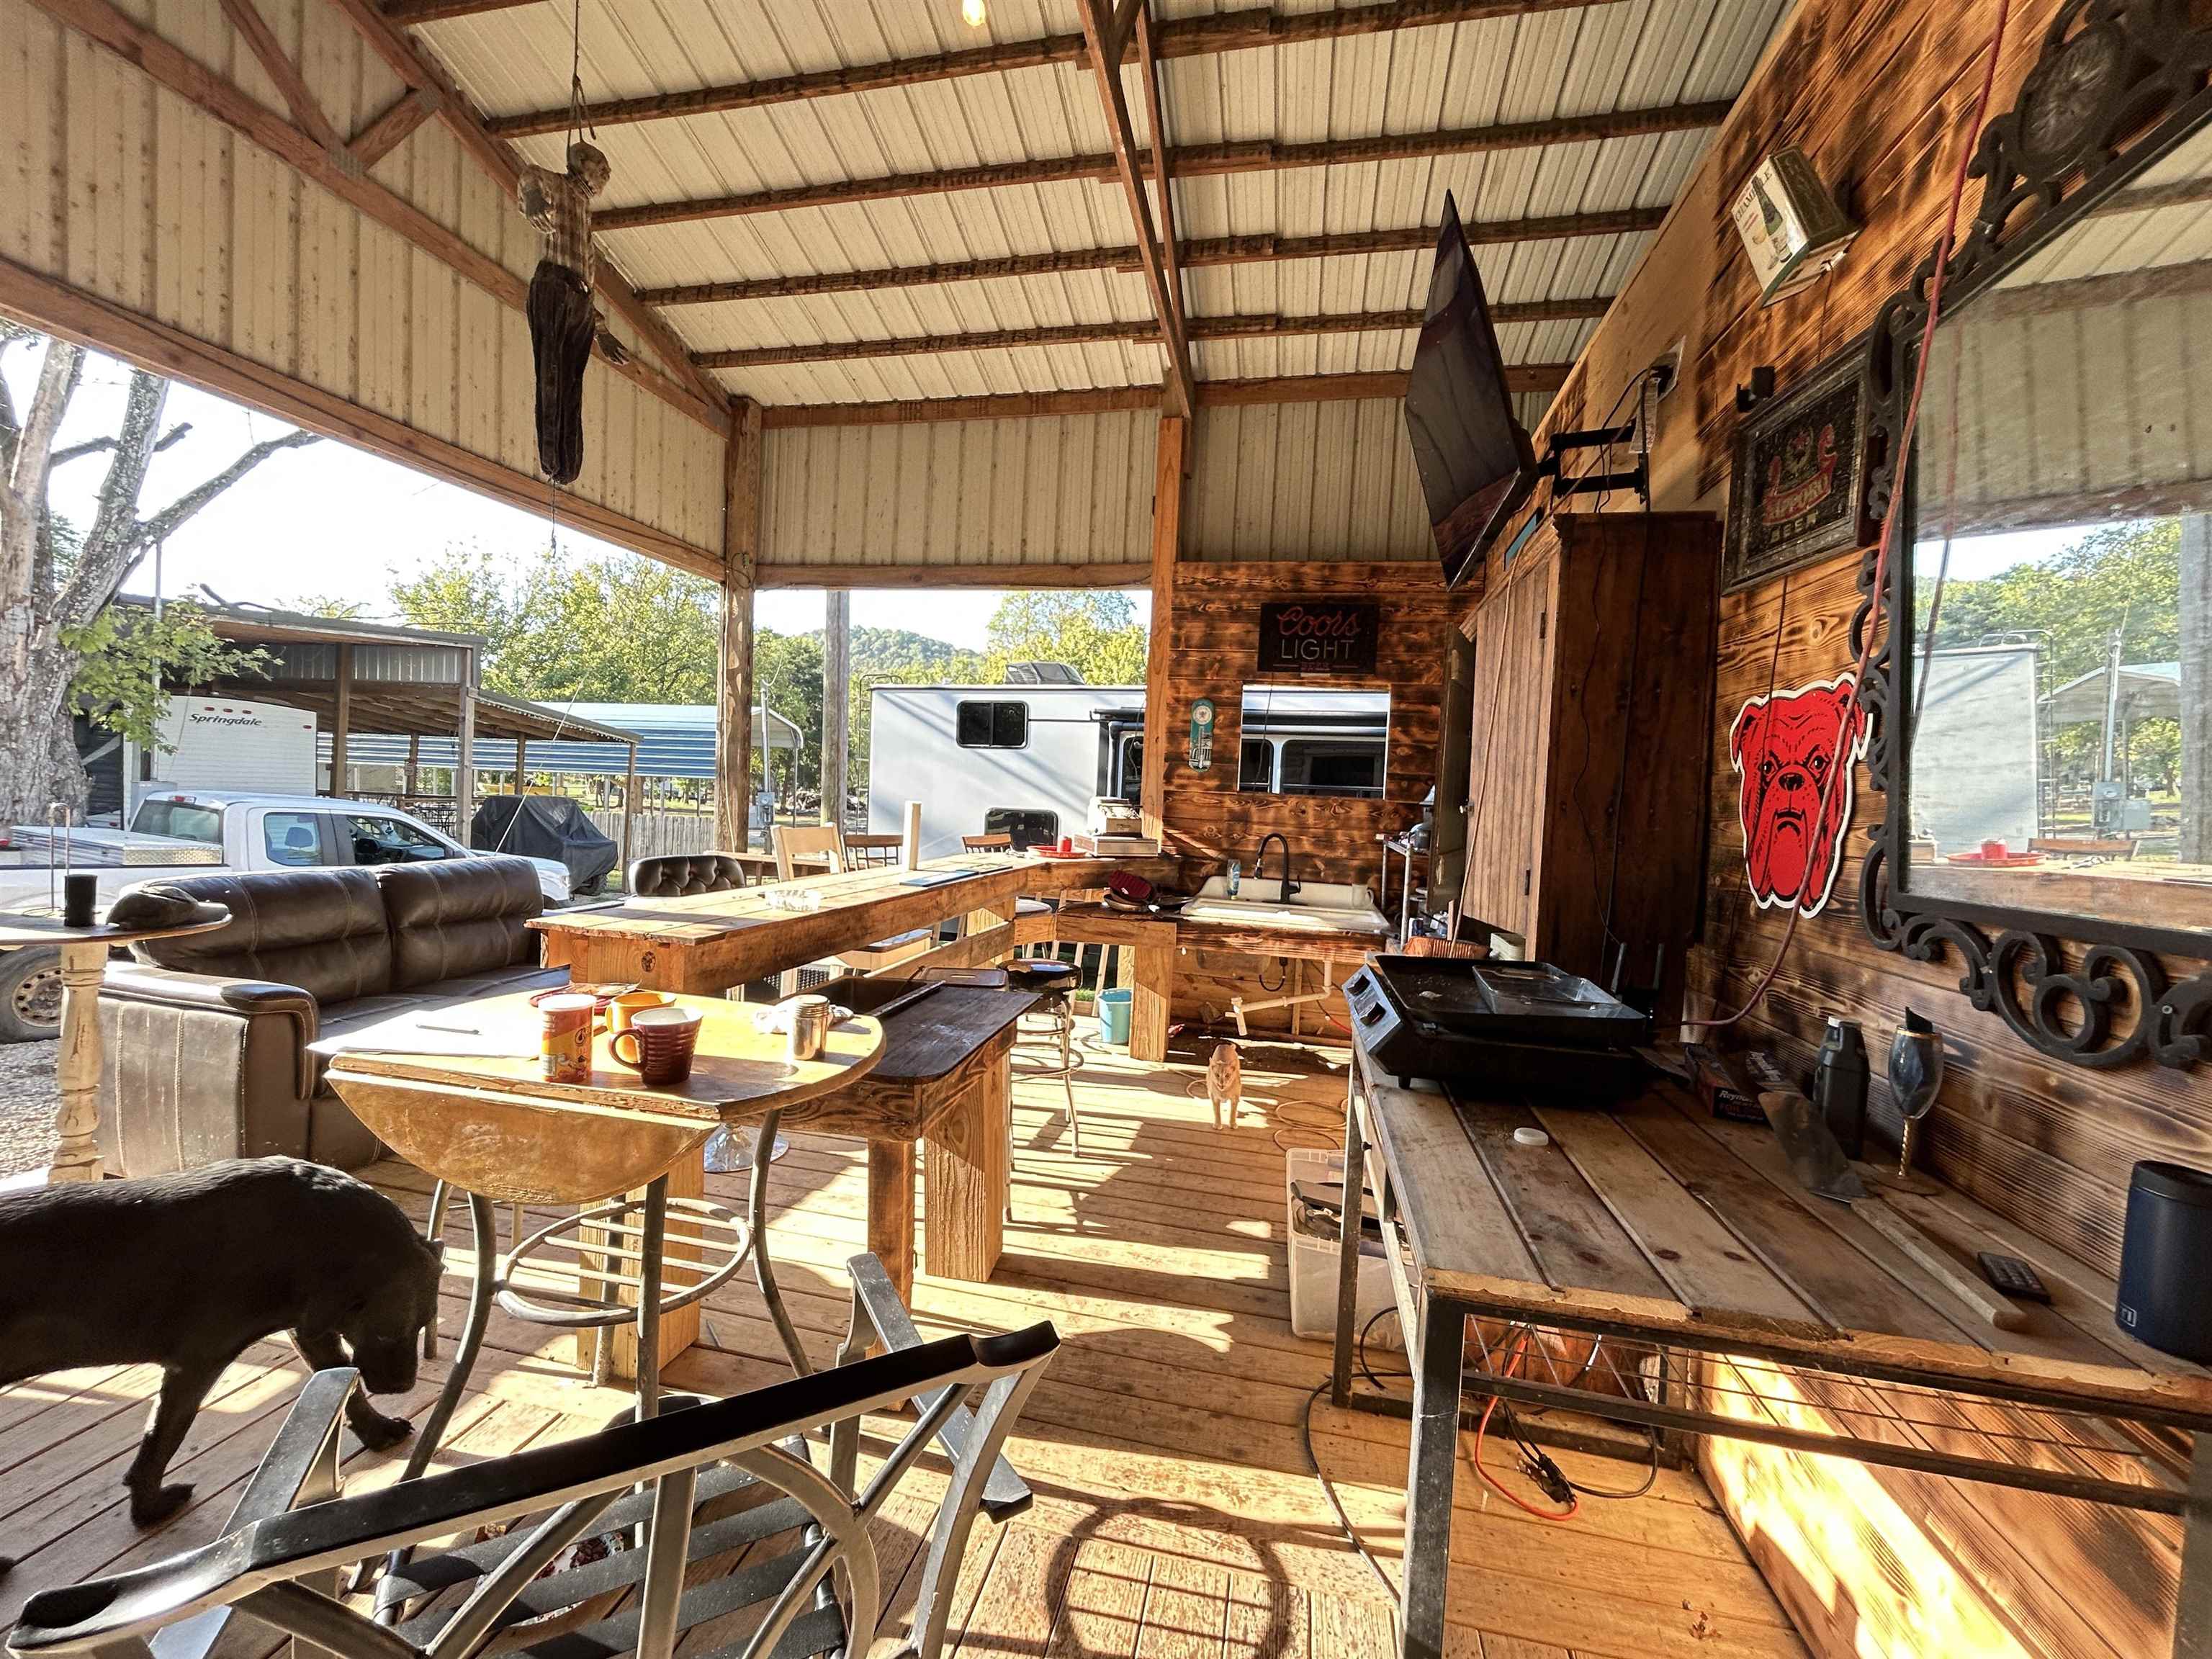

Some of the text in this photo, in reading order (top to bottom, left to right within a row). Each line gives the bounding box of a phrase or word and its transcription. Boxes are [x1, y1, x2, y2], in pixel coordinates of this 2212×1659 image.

[1278, 606, 1360, 636] Coors
[1281, 639, 1354, 660] LIGHT
[189, 713, 263, 726] Springdale
